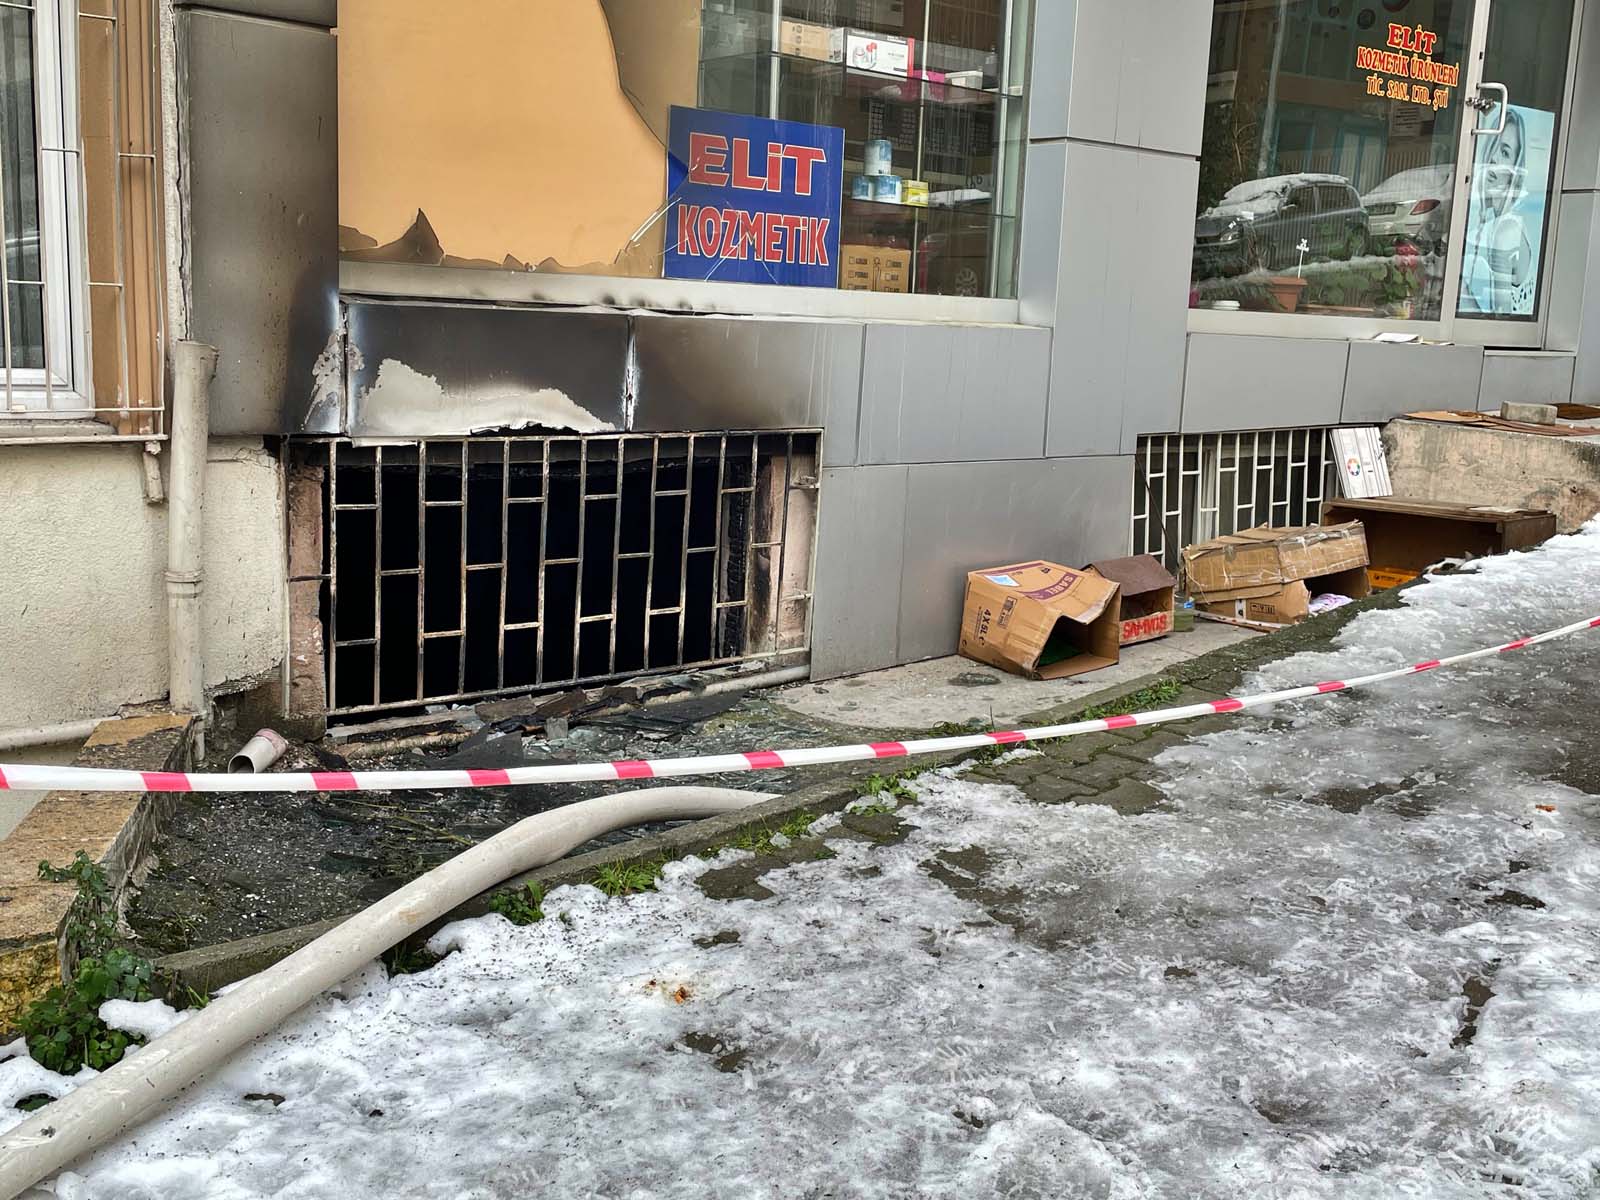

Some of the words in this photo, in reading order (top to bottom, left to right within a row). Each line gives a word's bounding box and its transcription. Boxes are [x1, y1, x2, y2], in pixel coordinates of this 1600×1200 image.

[1387, 23, 1437, 55] ELİT
[1356, 46, 1409, 77] KOZMETİK
[1410, 53, 1460, 87] ÜRÜNLERİ
[1387, 80, 1410, 101] SAN.
[1411, 84, 1431, 105] LTD.
